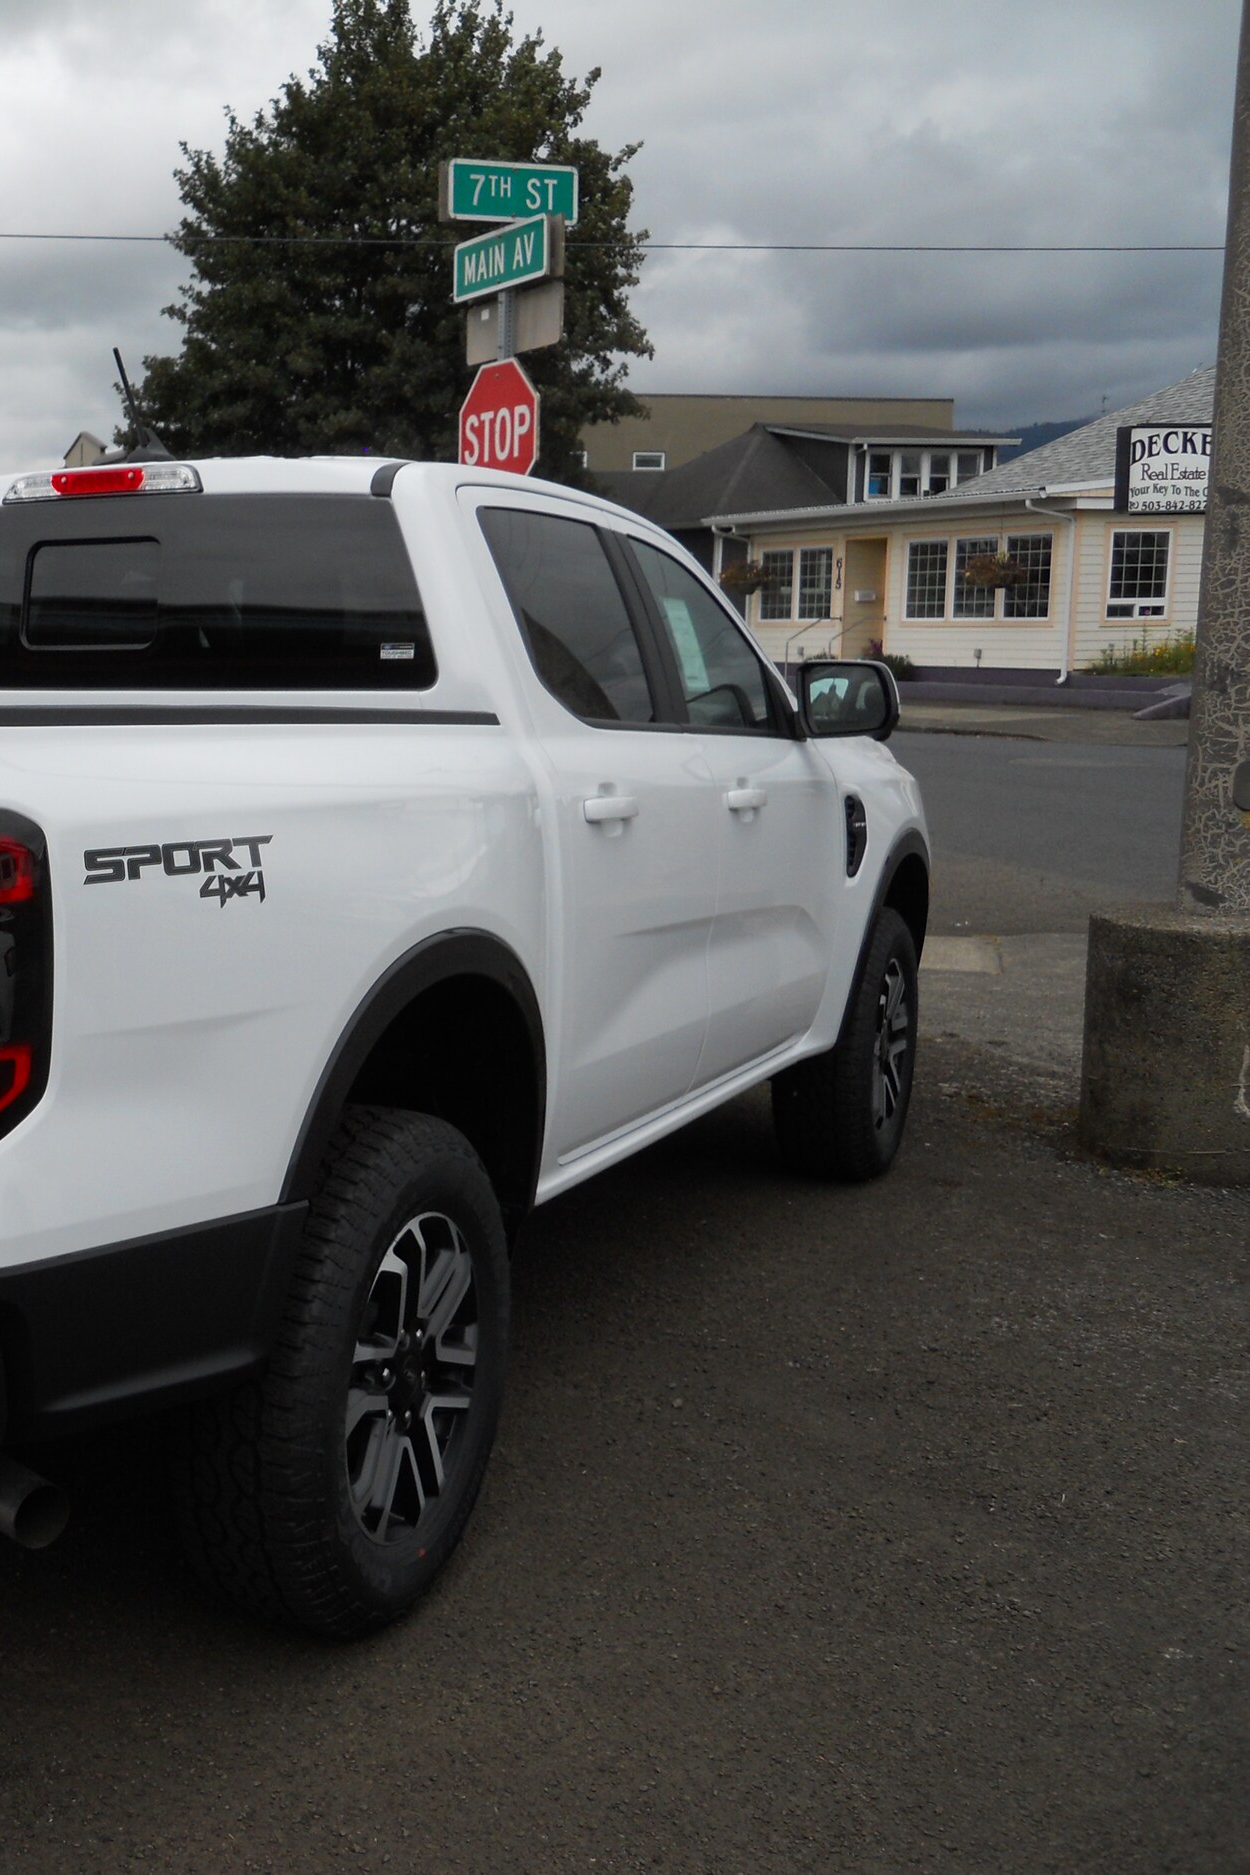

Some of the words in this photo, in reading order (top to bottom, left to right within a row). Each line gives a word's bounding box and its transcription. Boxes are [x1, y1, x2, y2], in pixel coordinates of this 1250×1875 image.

[470, 173, 511, 206] 7TH
[525, 178, 558, 211] ST
[464, 242, 505, 287] MAIN
[512, 231, 535, 271] AV
[464, 404, 531, 465] STOP
[1130, 486, 1151, 498] Your
[1152, 483, 1169, 497] Key
[1171, 485, 1182, 496] To
[1184, 486, 1201, 497] The
[1140, 463, 1168, 481] Real
[1170, 463, 1207, 481] Estate
[83, 834, 274, 885] SPORT
